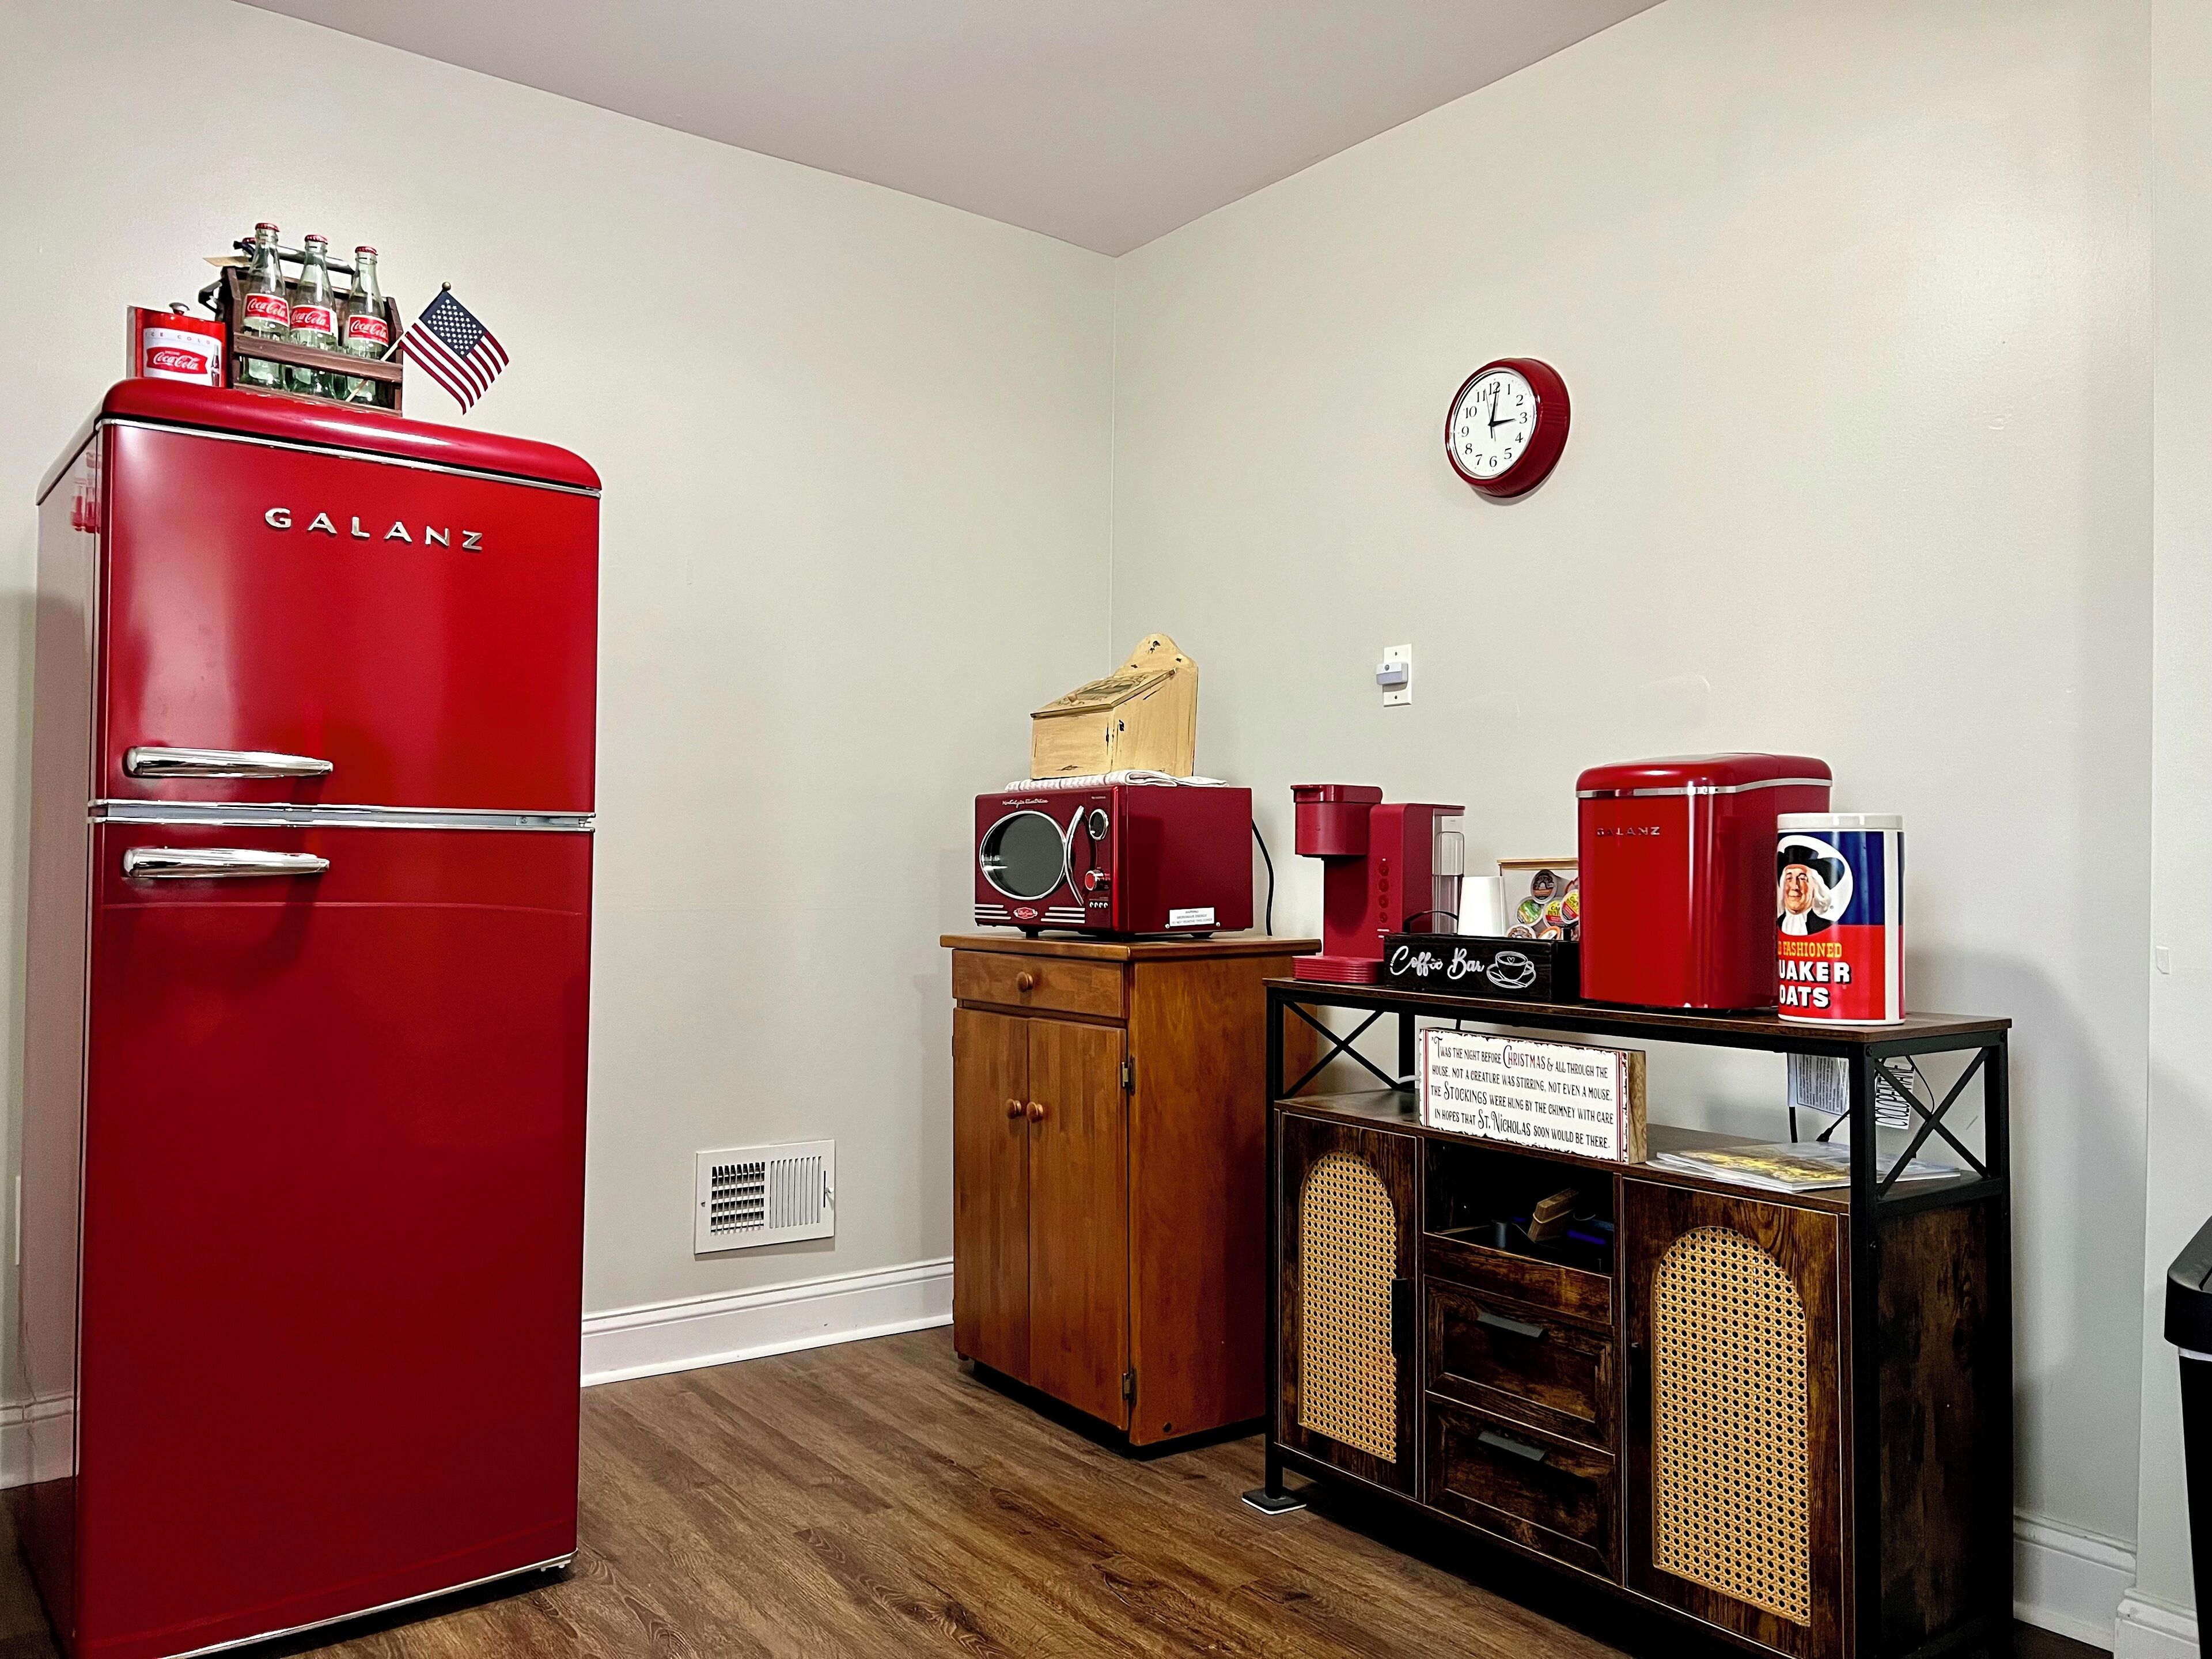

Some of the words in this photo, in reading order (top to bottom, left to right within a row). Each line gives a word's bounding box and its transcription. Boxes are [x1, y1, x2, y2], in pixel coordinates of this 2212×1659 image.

[247, 298, 286, 317] Coca-Cola
[177, 335, 210, 344] COLD
[153, 351, 199, 370] Coca-Cola
[1489, 382, 1501, 395] 12
[1507, 384, 1511, 395] 1
[1477, 390, 1486, 403] 11
[1516, 395, 1524, 406] 2
[1465, 406, 1477, 419] 10
[1519, 412, 1527, 423] 3
[1461, 426, 1469, 437] 9
[1515, 432, 1523, 443] 4
[1465, 443, 1472, 455] 8
[1503, 448, 1512, 459] 5
[1475, 454, 1483, 465] 7
[1489, 456, 1497, 467] 6
[265, 507, 482, 551] GALANZ
[1597, 827, 1660, 835] GALANZ
[1783, 941, 1842, 958] FASHIONED
[1389, 945, 1443, 976] Coffee
[1447, 948, 1484, 979] Bar
[1779, 959, 1851, 983] UAKER
[1779, 984, 1830, 1008] OATS
[1453, 1048, 1463, 1059] THE
[1464, 1049, 1480, 1061] NIGHT
[1482, 1051, 1502, 1064] BEFORE
[1503, 1045, 1545, 1069] CHRISTMAS
[1547, 1058, 1554, 1071] &
[1555, 1061, 1566, 1073] ALL
[1567, 1063, 1594, 1076] THROUGH
[1596, 1066, 1608, 1078] THE
[1452, 1067, 1463, 1079] NOT
[1465, 1069, 1469, 1080] A
[1471, 1070, 1500, 1084] CREATURE
[1502, 1075, 1515, 1086] WAS
[1516, 1077, 1546, 1092] STIRRING,
[1548, 1081, 1561, 1093] NOT
[1563, 1084, 1580, 1096] EVEN
[1582, 1086, 1586, 1097] A
[1431, 1085, 1441, 1096] THE
[1444, 1081, 1487, 1105] STOCKINGS
[1490, 1094, 1506, 1107] WERE
[1508, 1097, 1523, 1109] HUNG
[1525, 1100, 1532, 1112] BY
[1535, 1102, 1547, 1113] THE
[1548, 1104, 1575, 1118] CHIMNEY
[1578, 1108, 1595, 1122] WITH
[1597, 1112, 1613, 1124] CARE
[1435, 1108, 1441, 1119] IN
[1442, 1109, 1459, 1122] HOPES
[1461, 1113, 1476, 1125] THAT
[1533, 1125, 1550, 1138] SOON
[1551, 1128, 1574, 1142] WOULD
[1575, 1132, 1584, 1145] BE
[1586, 1134, 1610, 1149] THERE.
